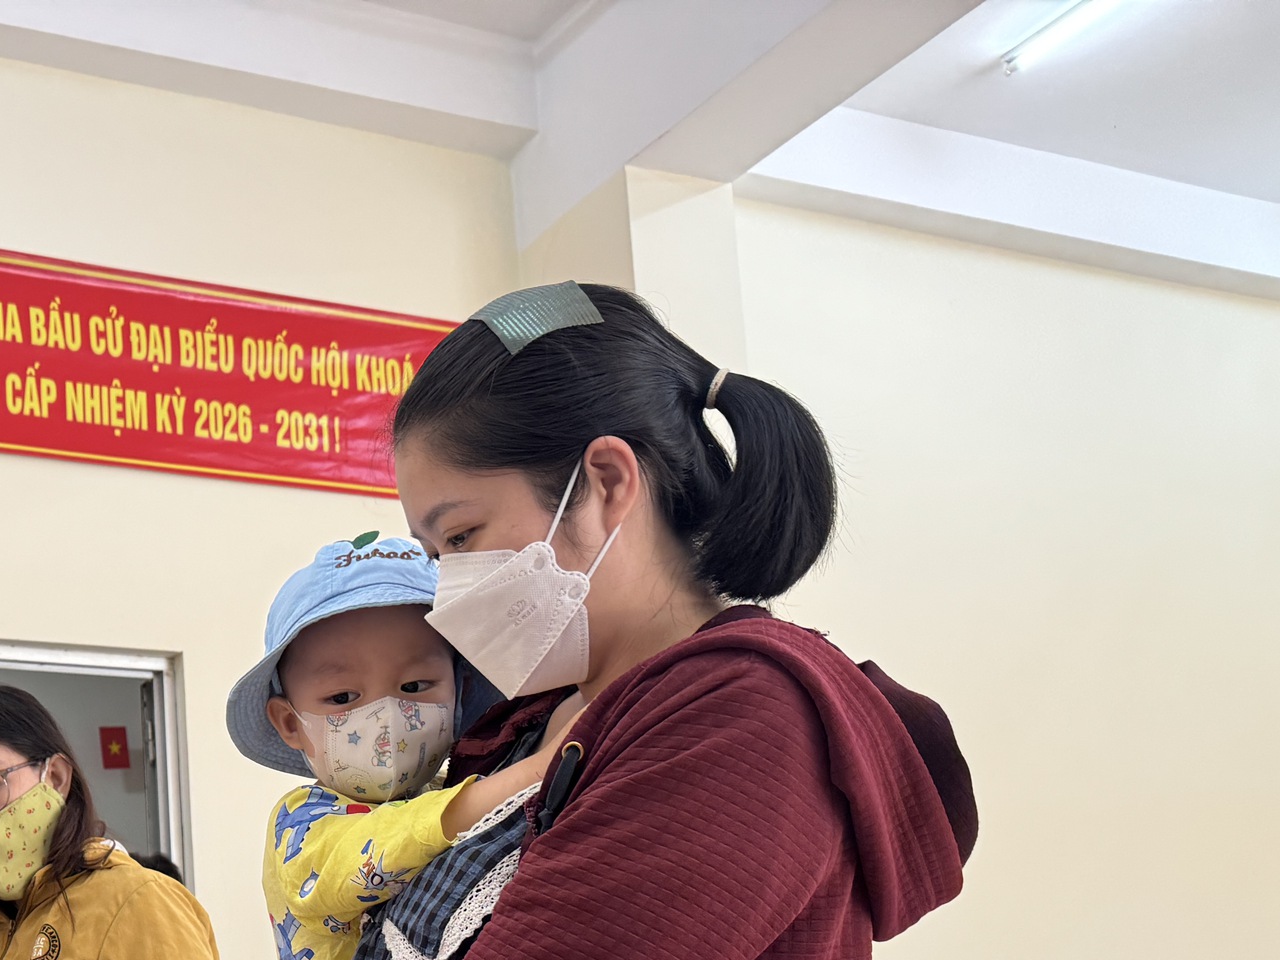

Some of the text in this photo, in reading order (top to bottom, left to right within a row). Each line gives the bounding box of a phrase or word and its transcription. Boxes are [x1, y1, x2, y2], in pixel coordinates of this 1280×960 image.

[29, 296, 82, 352] BẦU
[89, 305, 125, 358] CỬ
[130, 321, 173, 373] ĐẠI
[179, 318, 235, 374] BIỂU
[242, 329, 305, 384] QUỐC
[311, 341, 350, 397] HỘI
[5, 360, 58, 419] CẤP
[66, 378, 149, 437] NHIỆM
[156, 386, 187, 436] KỲ
[194, 398, 253, 444] 2026
[259, 423, 269, 434] -
[276, 408, 341, 454] 2031!
